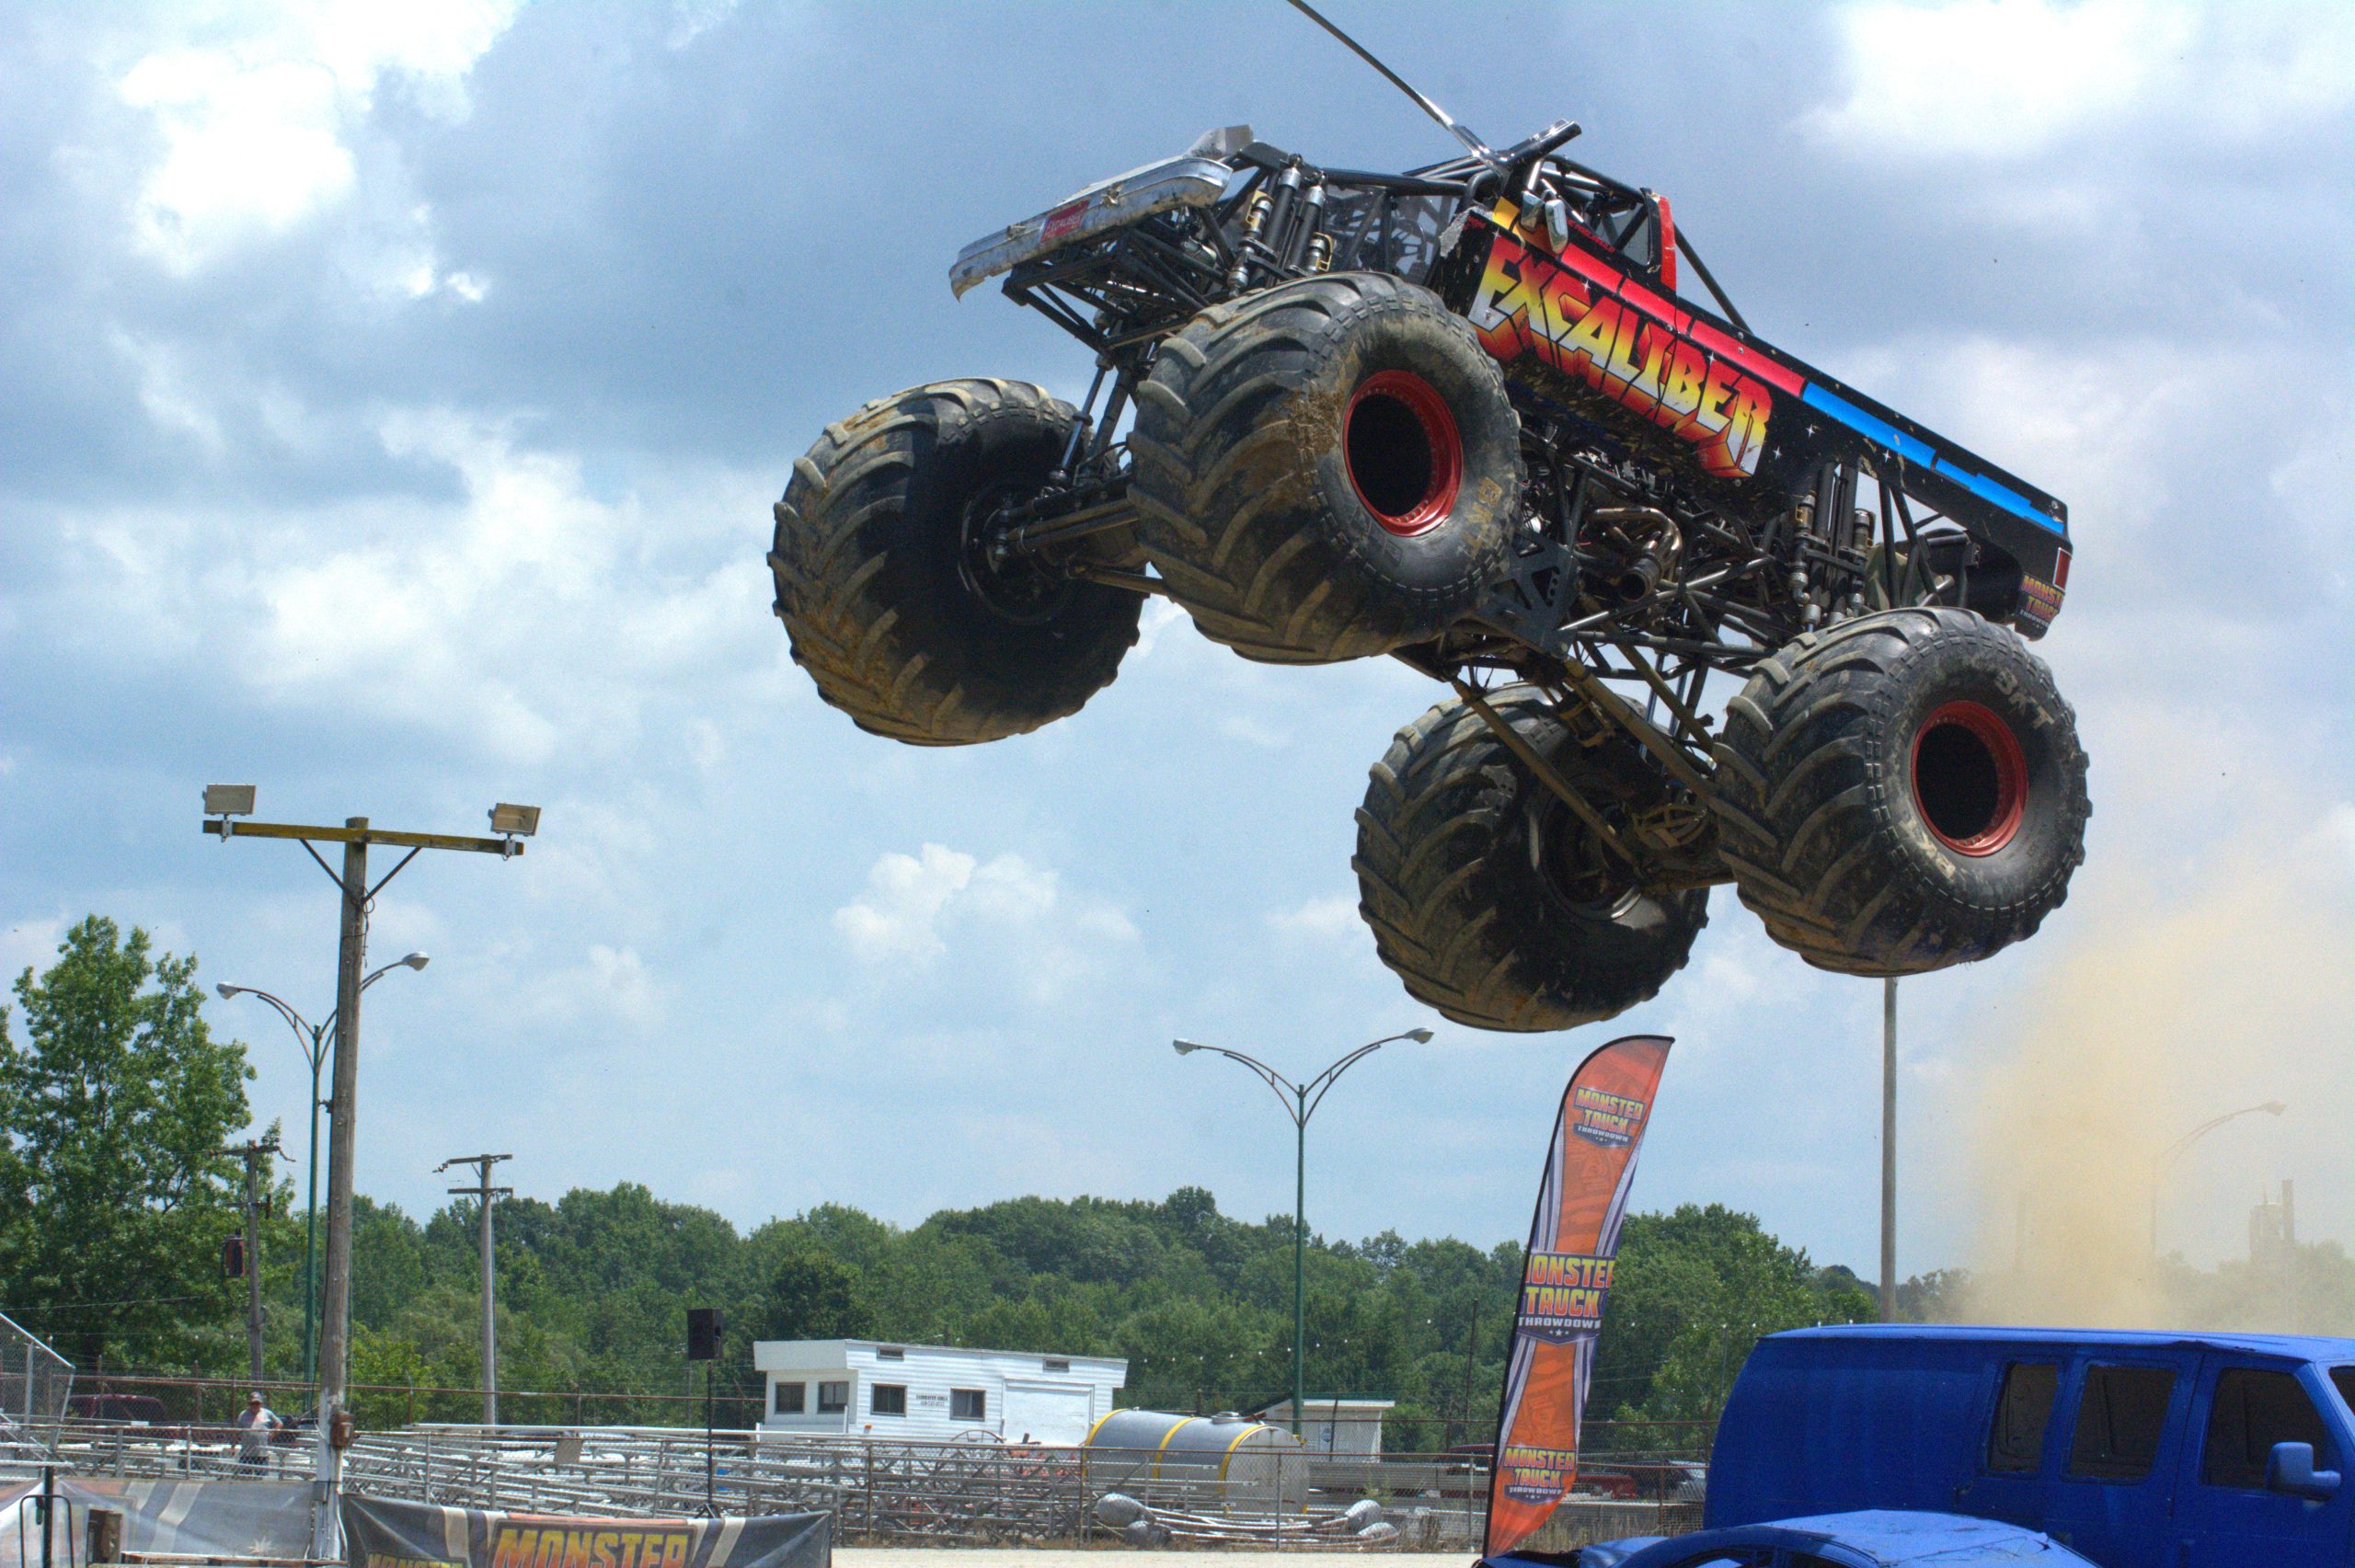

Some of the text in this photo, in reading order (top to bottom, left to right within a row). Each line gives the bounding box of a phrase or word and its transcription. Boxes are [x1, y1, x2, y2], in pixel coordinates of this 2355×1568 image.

[1468, 234, 1774, 476] EXCALIBER
[2020, 574, 2065, 608] MONST
[1574, 1088, 1645, 1120] MONSTER
[1577, 1125, 1629, 1142] THROWDOWN
[1583, 1109, 1629, 1135] TRUCK
[1525, 1254, 1615, 1288] ONSTE
[1526, 1286, 1601, 1318] TRUCK
[1503, 1447, 1576, 1471] MONSTER
[1513, 1468, 1561, 1488] TRUCK
[492, 1528, 689, 1568] MONSTER
